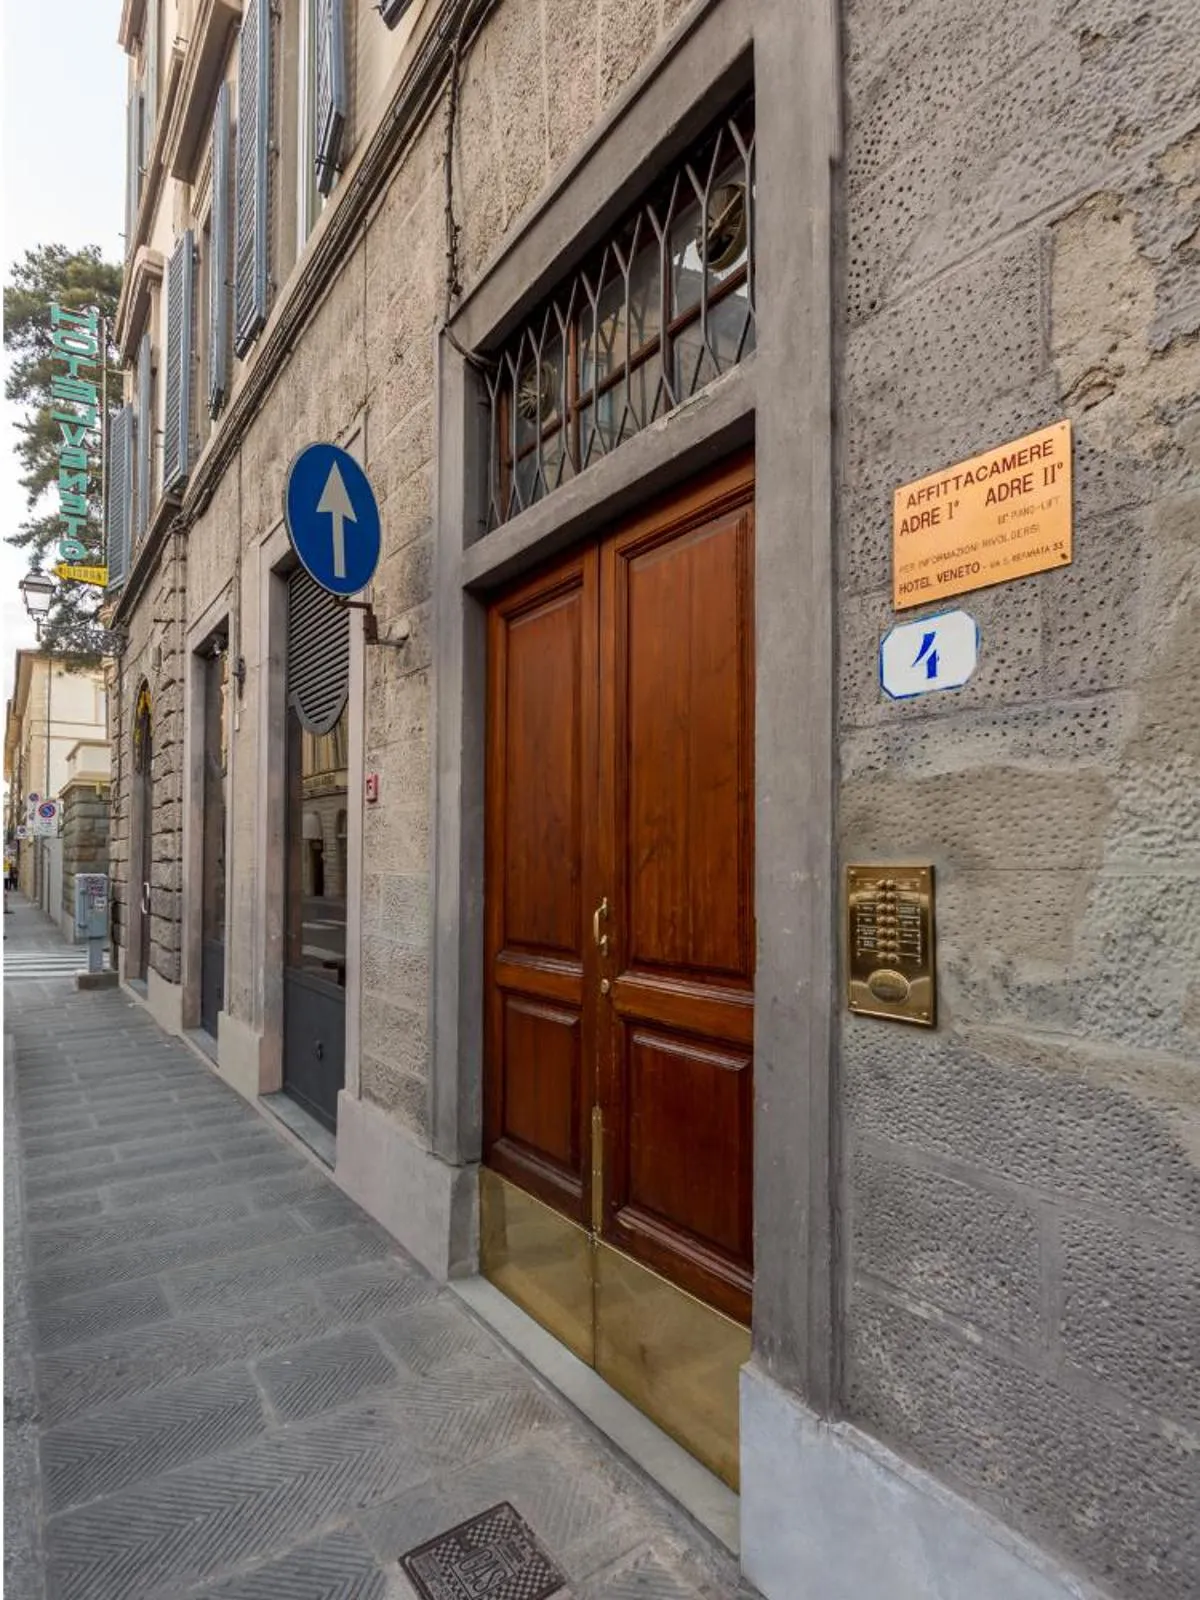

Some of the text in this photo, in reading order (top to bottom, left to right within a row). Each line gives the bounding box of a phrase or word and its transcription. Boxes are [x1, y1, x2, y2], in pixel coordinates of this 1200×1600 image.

[906, 438, 1054, 509] AFFITTACAMERE
[984, 473, 1034, 507] ADRE
[899, 508, 941, 537] ADRE
[898, 576, 932, 594] HOTEL
[936, 560, 980, 584] VENETO
[911, 630, 940, 679] 4
[460, 1549, 508, 1592] GAS
